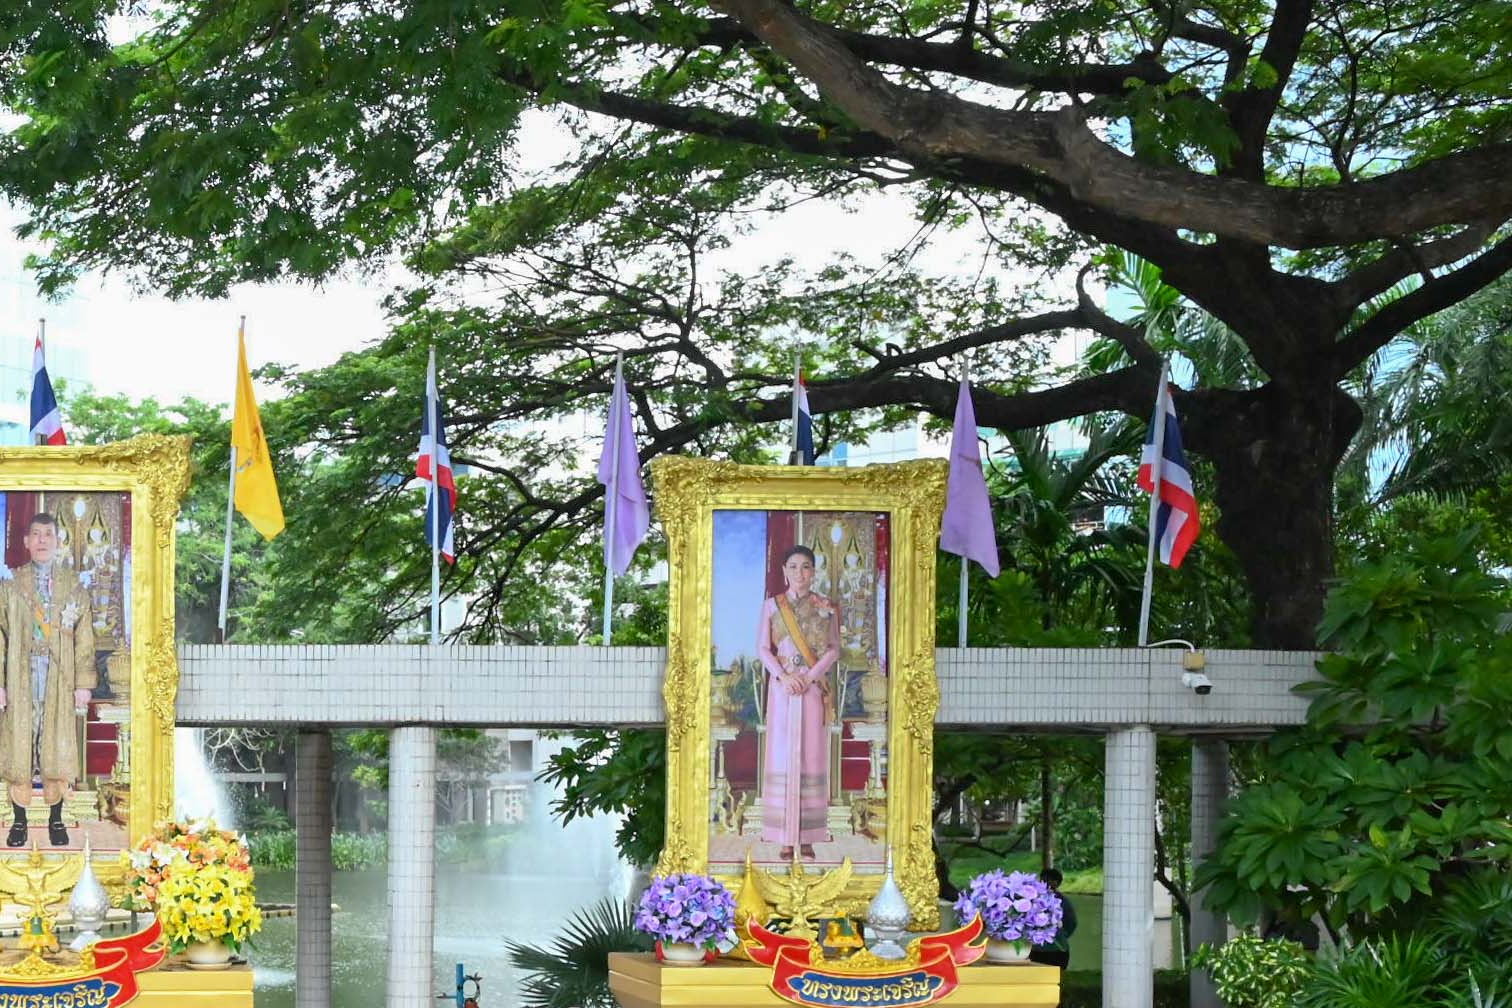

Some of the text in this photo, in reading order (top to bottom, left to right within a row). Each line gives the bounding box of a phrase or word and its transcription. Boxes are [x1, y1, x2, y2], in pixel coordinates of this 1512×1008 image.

[802, 977, 930, 1002] ทรงพระเจริญ
